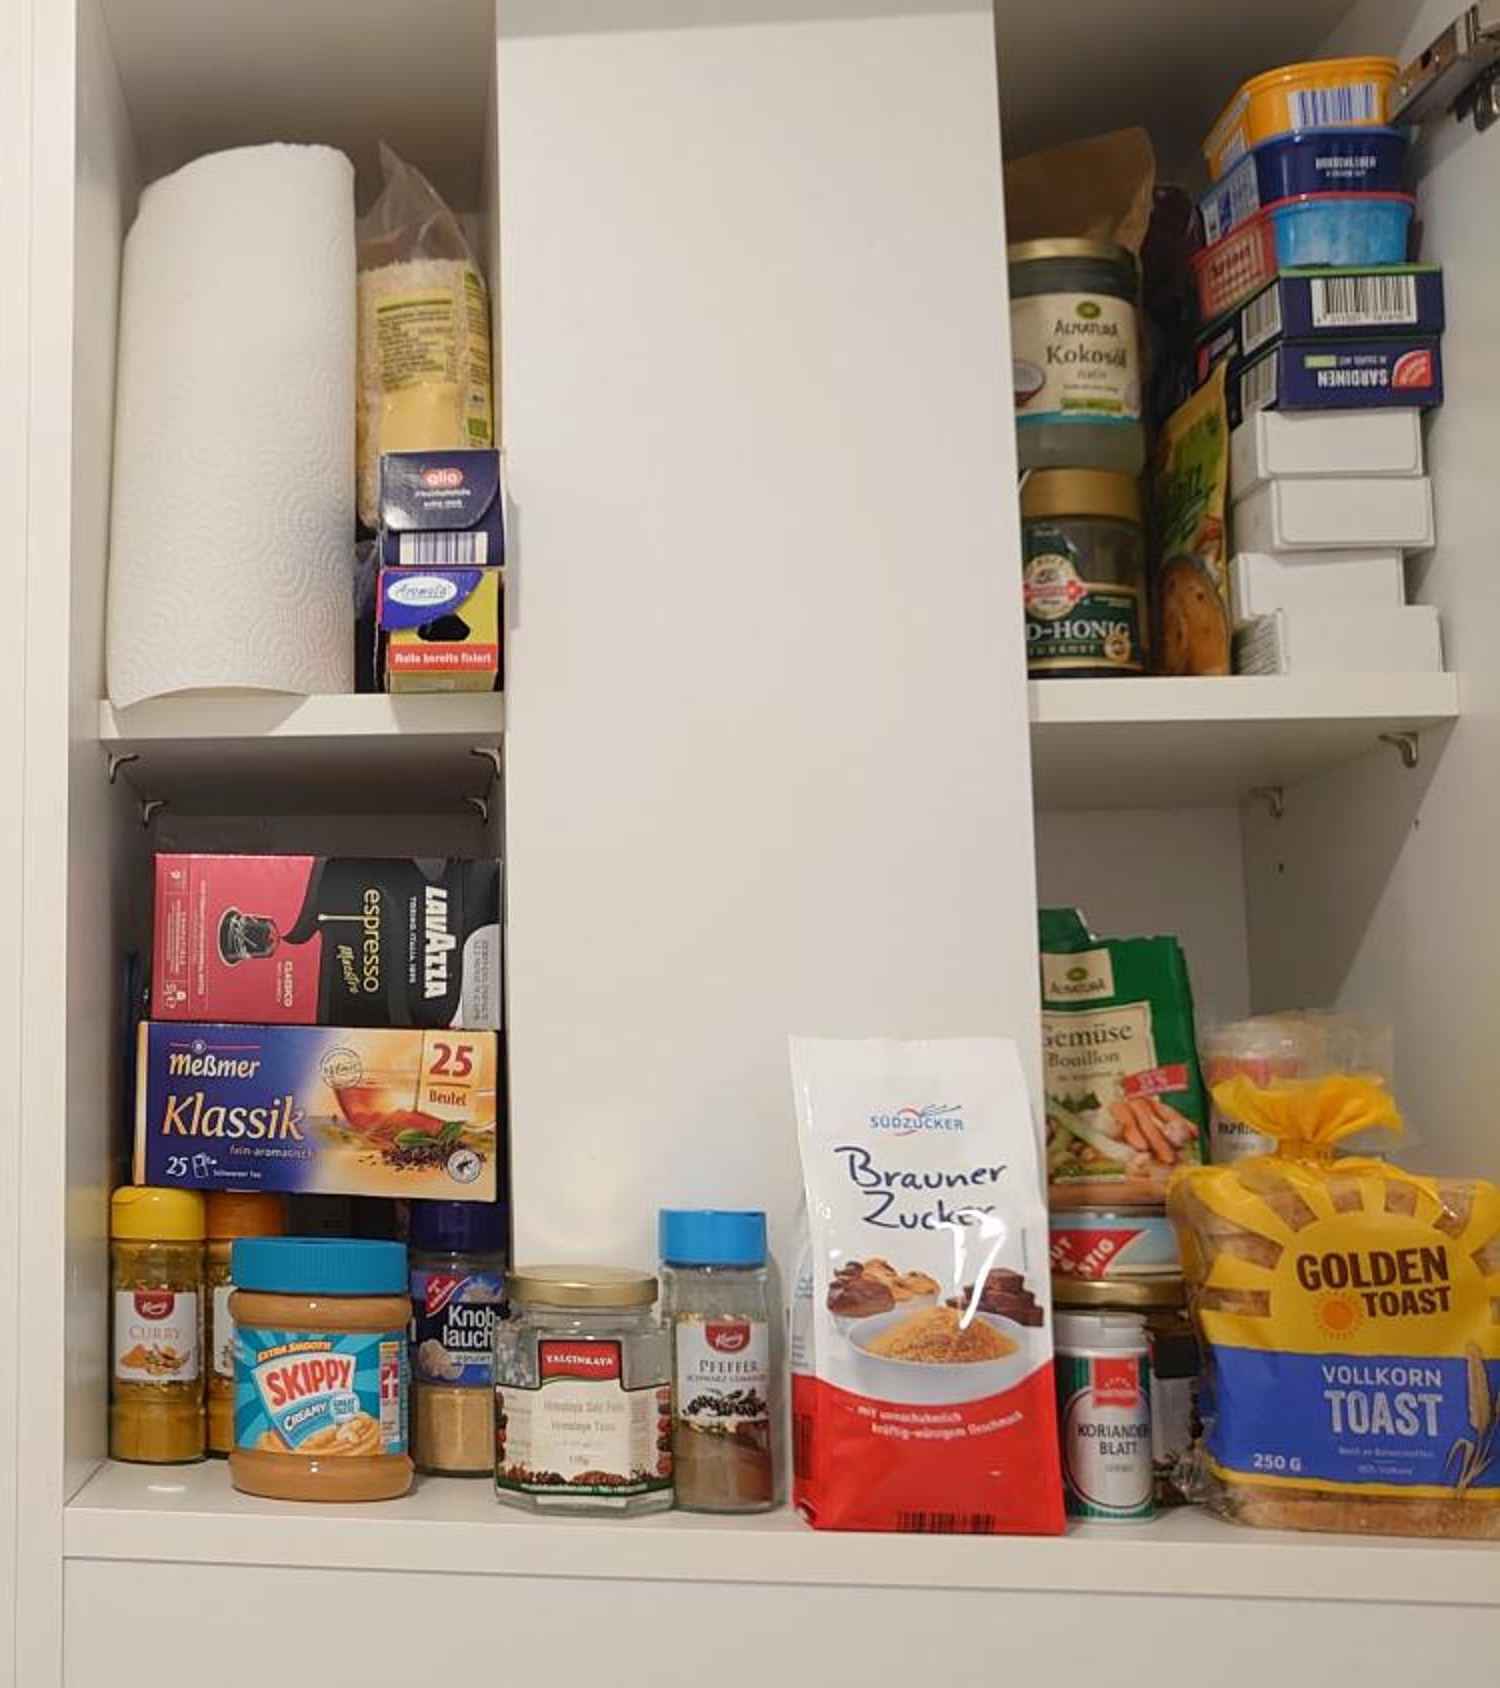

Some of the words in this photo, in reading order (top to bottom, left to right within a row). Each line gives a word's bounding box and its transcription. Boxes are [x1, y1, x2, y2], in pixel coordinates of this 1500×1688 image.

[1046, 343, 1127, 369] Kokosöl
[1317, 369, 1389, 388] SARDINEN
[423, 885, 457, 999] LAVAZZA
[429, 1041, 474, 1078] 25
[1047, 1049, 1120, 1068] Bouillon
[428, 1088, 468, 1108] Beutel
[161, 1091, 308, 1140] Klassik
[869, 1115, 965, 1131] SÜDZUCKER
[165, 1155, 189, 1177] 25
[833, 1145, 1008, 1190] Brauner
[1296, 1245, 1449, 1291] GOLDEN
[1361, 1285, 1452, 1318] TOAST
[447, 1303, 501, 1328] Knob-
[128, 1325, 182, 1340] CURRY
[442, 1323, 493, 1348] lauch
[699, 1359, 758, 1373] PFEFFER
[1321, 1365, 1443, 1388] VOLLKORN
[265, 1358, 352, 1407] SKIPPY
[1323, 1389, 1443, 1437] TOAST
[1099, 1441, 1138, 1456] BLATT
[1253, 1452, 1286, 1470] 250
[1289, 1456, 1301, 1471] G
